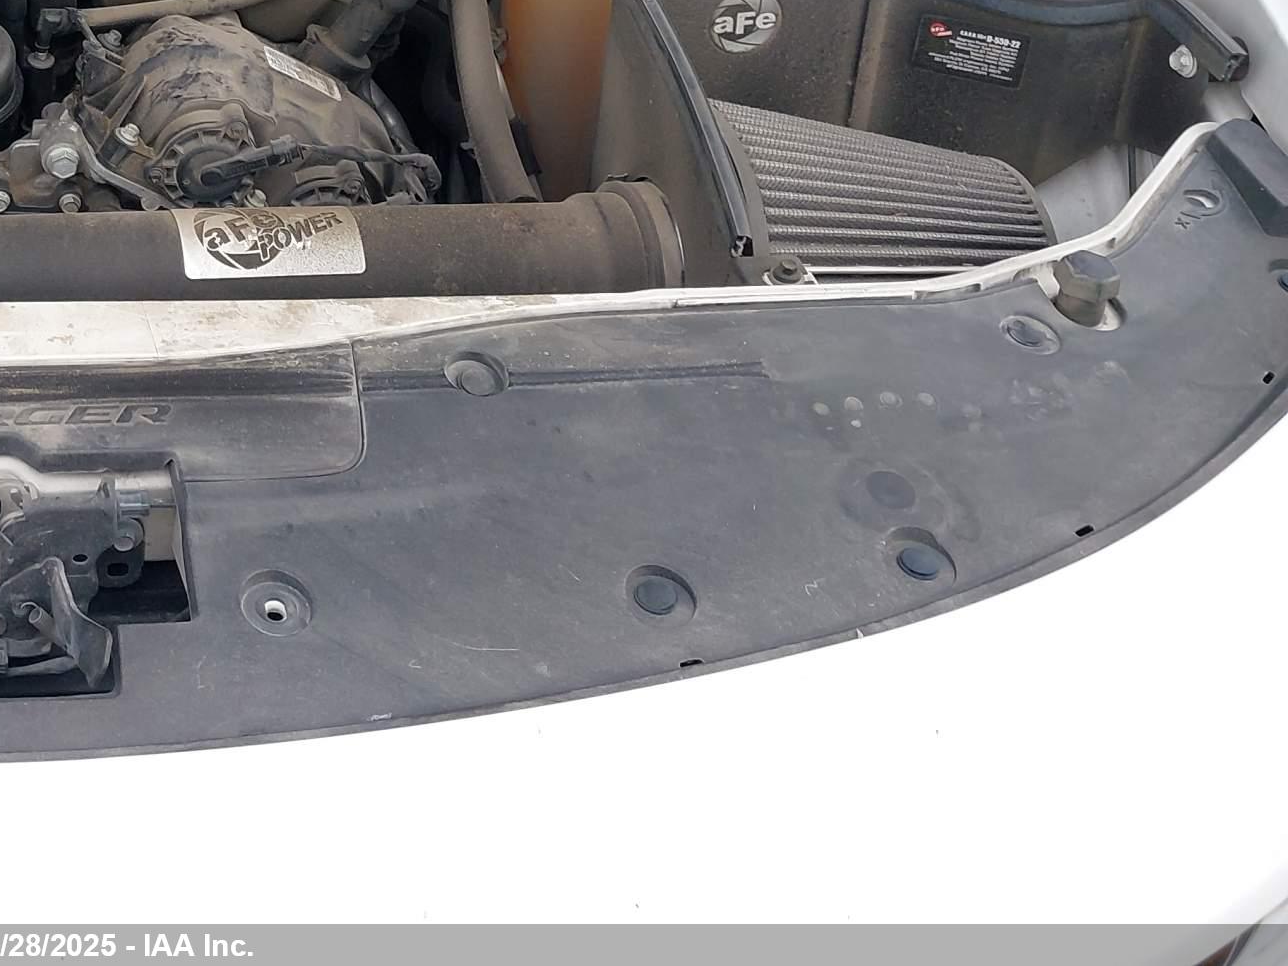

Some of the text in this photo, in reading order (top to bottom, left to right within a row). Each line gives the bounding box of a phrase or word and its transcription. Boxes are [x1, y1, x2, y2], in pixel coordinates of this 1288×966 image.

[713, 11, 777, 35] aFe
[204, 213, 277, 251] aFe
[257, 211, 343, 261] POWER
